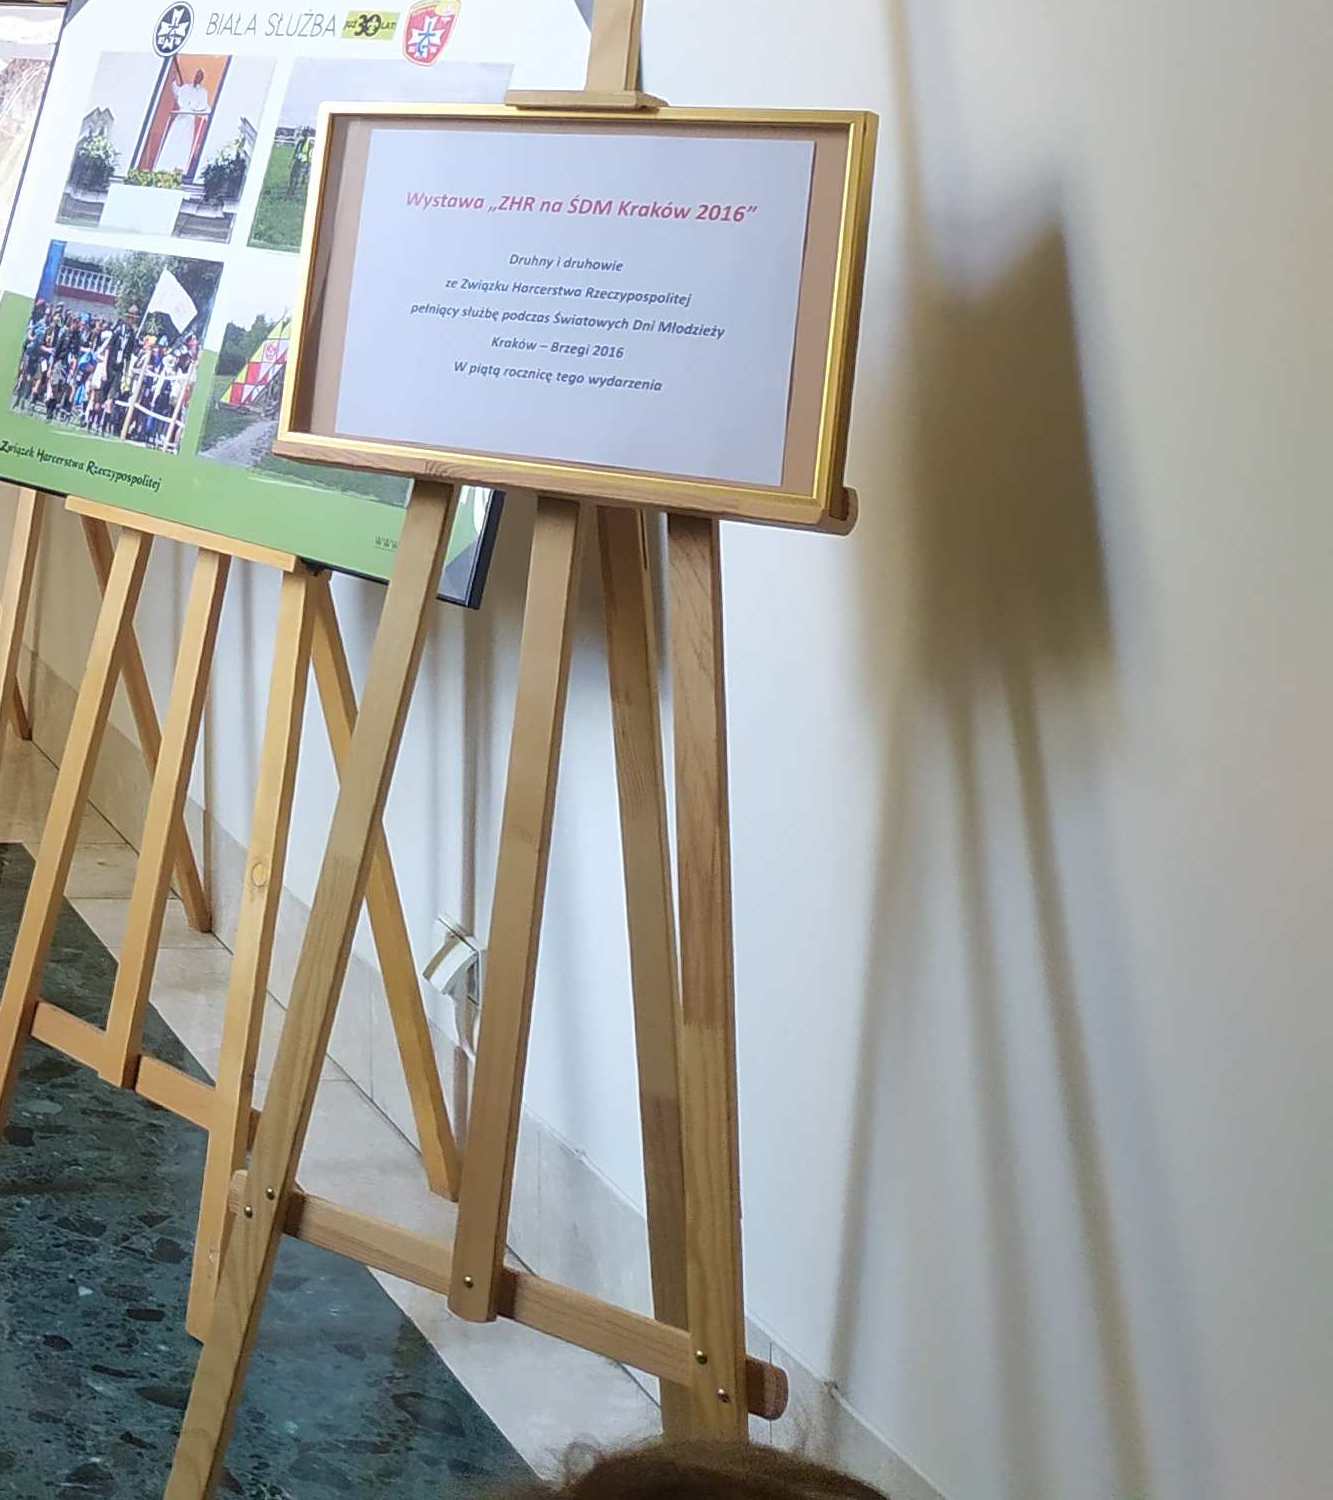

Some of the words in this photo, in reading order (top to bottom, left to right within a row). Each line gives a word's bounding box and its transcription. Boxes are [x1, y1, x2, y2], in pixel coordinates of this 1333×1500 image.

[205, 12, 257, 36] BIAŁA
[264, 8, 336, 38] SŁUŻBA
[353, 13, 382, 38] 30
[405, 191, 485, 211] Wystawa
[487, 195, 535, 213] „ZHR
[539, 201, 563, 213] na
[567, 194, 613, 216] ŚDM
[617, 200, 692, 220] Kraków
[509, 253, 555, 270] Druhny
[556, 256, 561, 268] i
[563, 257, 624, 272] druhowie
[445, 279, 458, 289] ze
[461, 278, 509, 293] Związku
[511, 282, 582, 297] Harcerstwa
[585, 286, 693, 308] Rzeczypospolitej
[409, 303, 460, 319] pełniący
[461, 306, 500, 322] służbę
[501, 310, 550, 324] podczas
[553, 311, 629, 331] Światowych
[632, 319, 655, 332] Dni
[658, 321, 725, 340] Młodzieży
[491, 336, 537, 351] Kraków
[550, 341, 590, 357] Brzegi
[592, 344, 625, 359] 2016
[453, 360, 468, 373] W
[469, 362, 501, 378] piątą
[503, 366, 553, 383] rocznicę
[556, 371, 584, 386] tego
[588, 375, 663, 392] wydarzenia
[0, 440, 35, 458] Związek
[36, 447, 84, 470] Harcerstwa
[86, 459, 162, 492] Rzeczypospolitej
